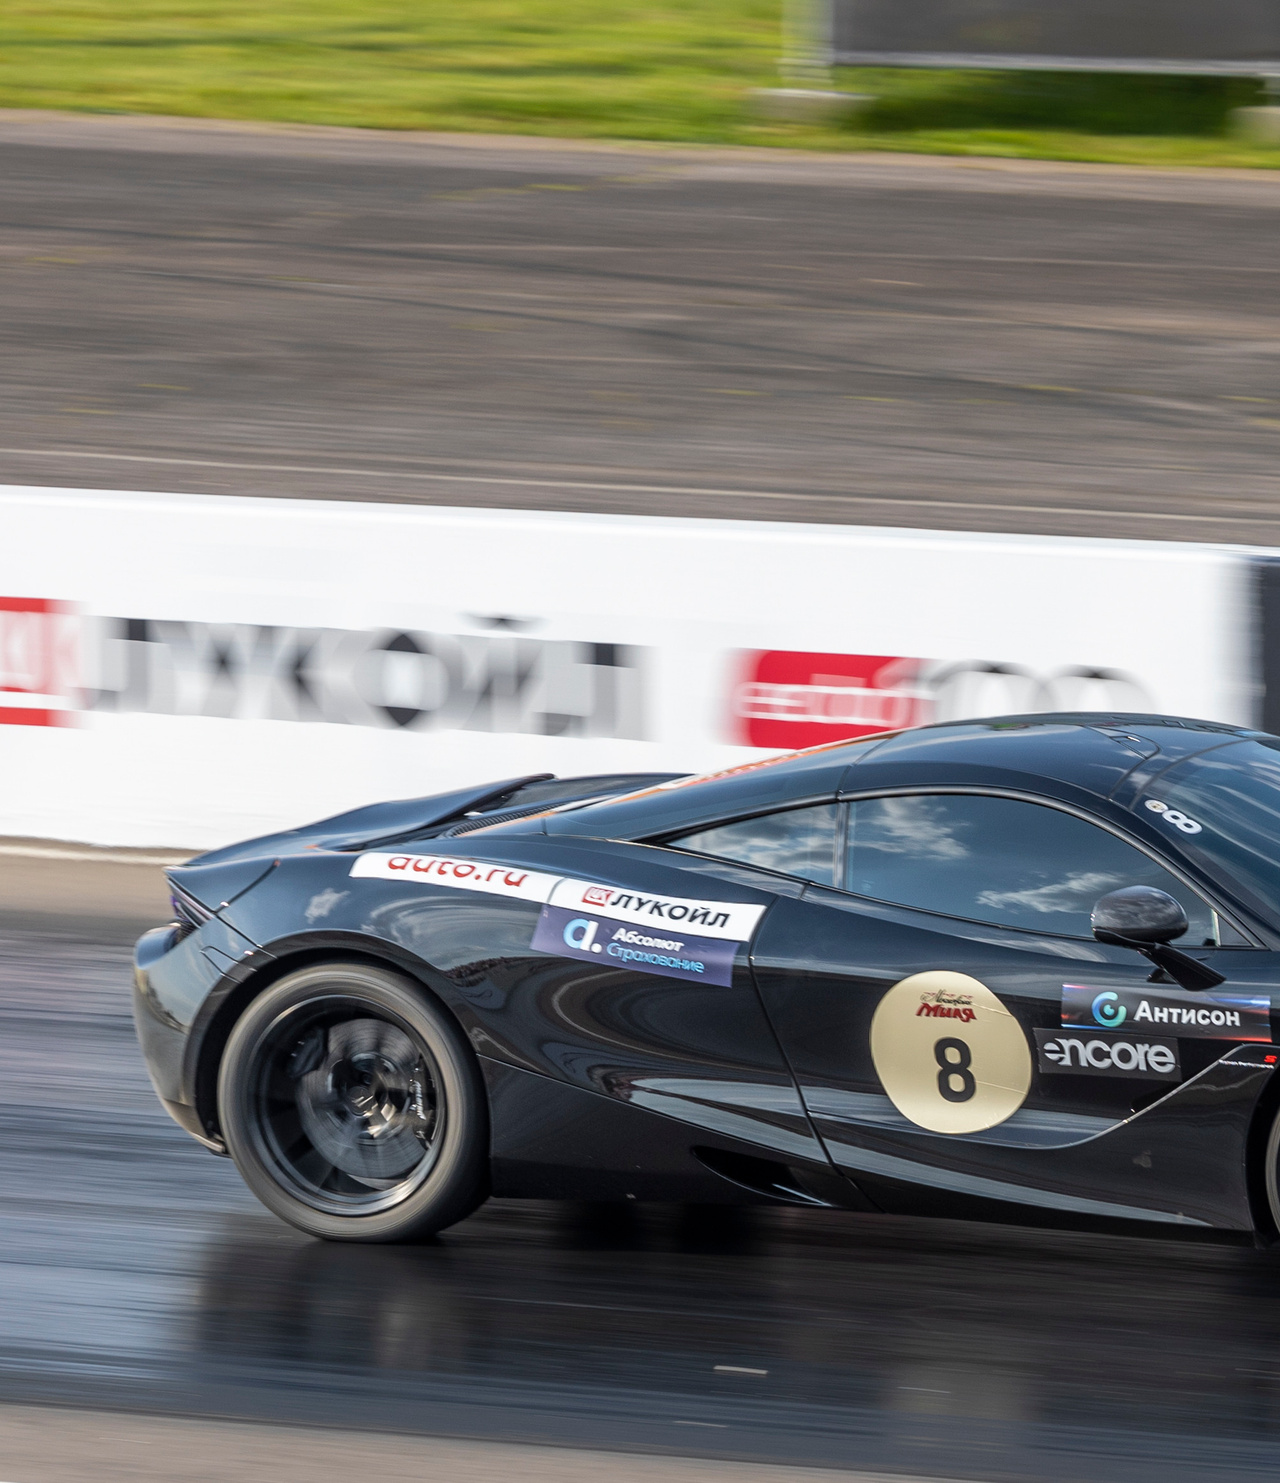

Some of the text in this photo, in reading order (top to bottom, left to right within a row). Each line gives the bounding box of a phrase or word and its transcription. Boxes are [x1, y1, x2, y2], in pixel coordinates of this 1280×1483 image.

[1161, 809, 1203, 834] 8
[387, 854, 529, 887] auto.ru
[610, 893, 731, 928] ЛУКОЙЛ
[611, 927, 685, 952] Абсолют
[606, 942, 706, 974] Страхование
[934, 1037, 976, 1103] 8
[1043, 1037, 1176, 1073] encore
